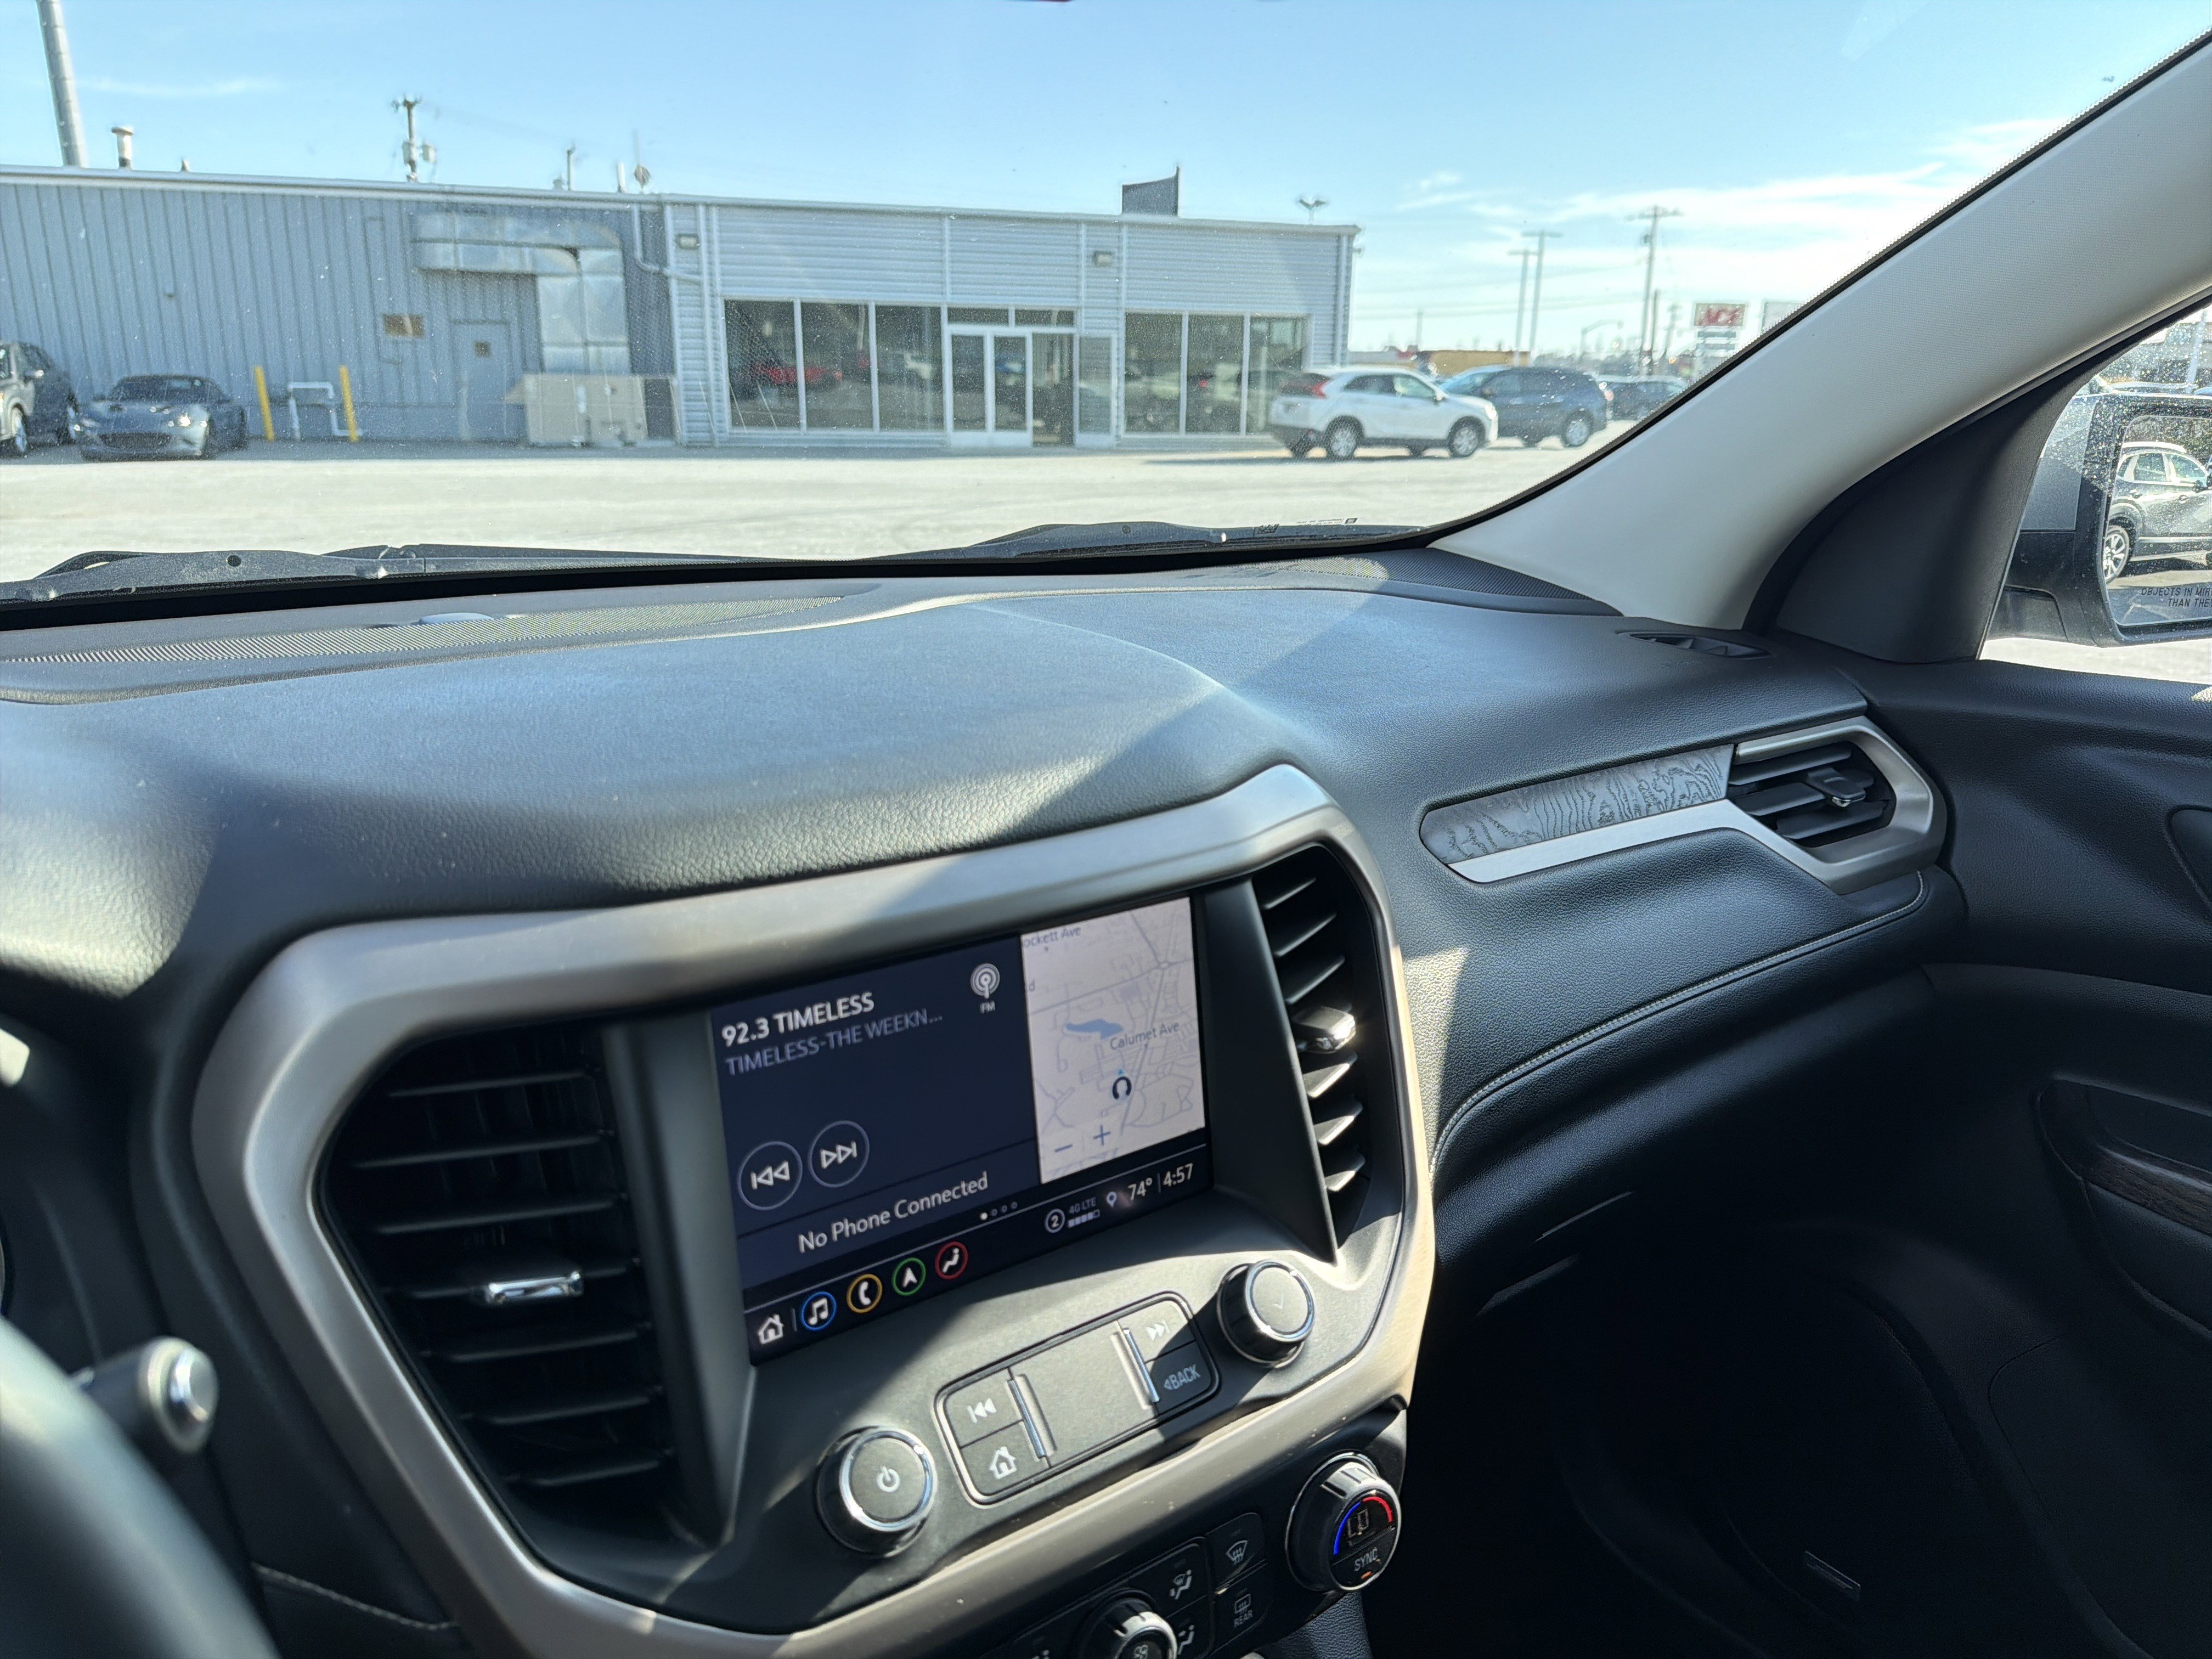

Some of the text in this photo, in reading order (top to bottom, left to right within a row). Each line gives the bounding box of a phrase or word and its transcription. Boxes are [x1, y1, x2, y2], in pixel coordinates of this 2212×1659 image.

[2141, 587, 2212, 596] OBJECTS IN MIR
[2168, 599, 2212, 607] THAN THE
[1062, 927, 1081, 938] Ave
[980, 1001, 995, 1013] FM
[722, 992, 875, 1047] 92.3 TIMELESS
[1110, 1021, 1180, 1050] Calumet Ave
[1128, 1163, 1193, 1201] 74° 4:57
[799, 1171, 988, 1253] No Phone Connected
[1081, 1197, 1097, 1211] LTE
[1051, 1214, 1059, 1228] 2
[1169, 1364, 1201, 1389] BACK
[1354, 1547, 1379, 1572] SYNC
[1234, 1610, 1253, 1628] REAR
